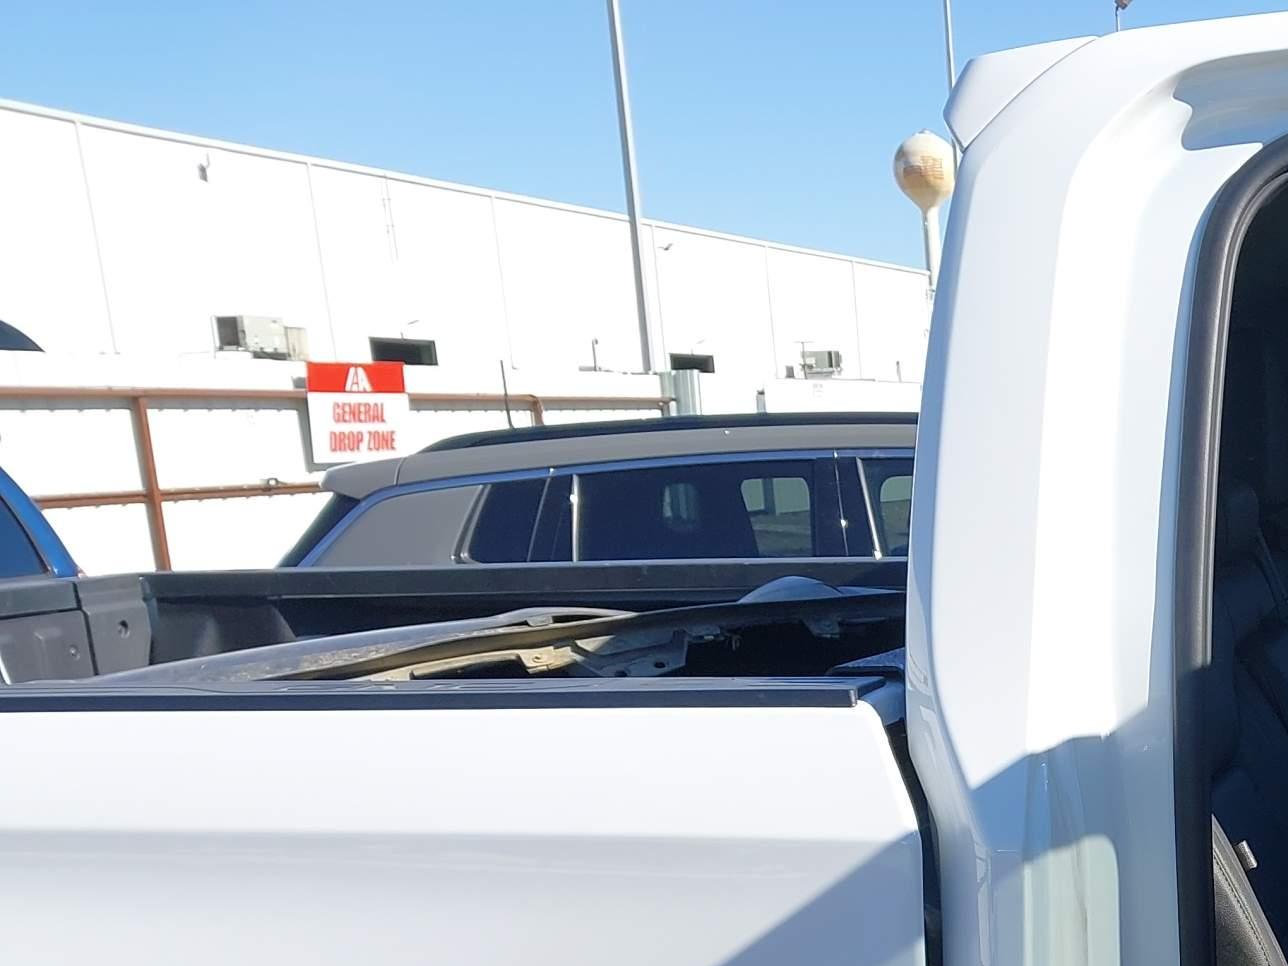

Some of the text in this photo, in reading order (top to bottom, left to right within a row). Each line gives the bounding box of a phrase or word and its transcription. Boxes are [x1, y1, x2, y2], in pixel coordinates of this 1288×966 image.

[332, 402, 387, 424] GENERAL
[329, 430, 396, 453] DROP ZONE
